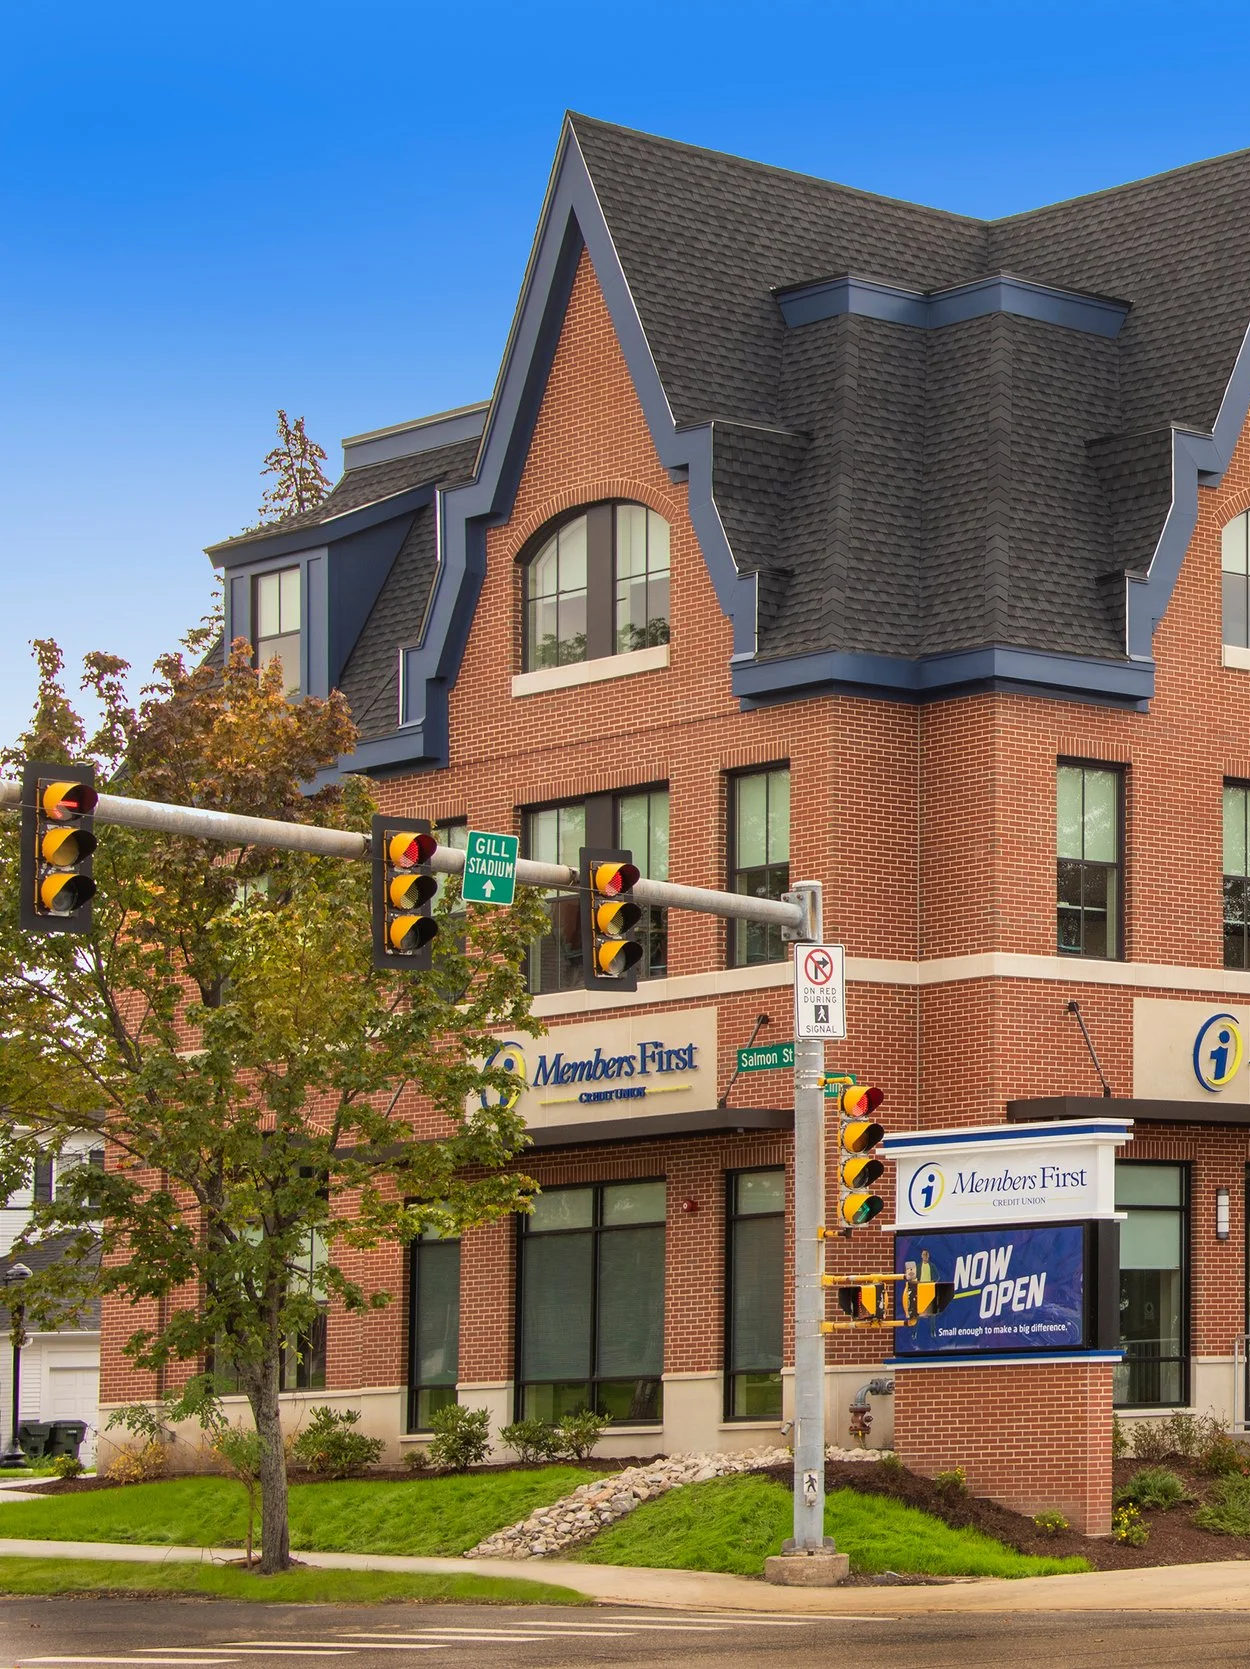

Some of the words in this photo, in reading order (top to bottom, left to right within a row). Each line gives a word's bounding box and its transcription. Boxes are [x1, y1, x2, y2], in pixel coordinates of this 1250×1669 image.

[476, 838, 509, 858] GILL
[468, 857, 514, 879] STADIUM
[803, 987, 816, 995] ON
[820, 987, 837, 995] RED
[803, 996, 837, 1004] DURING
[806, 1025, 837, 1034] SIGNAL
[531, 1047, 636, 1087] Members
[637, 1041, 698, 1074] First
[741, 1052, 778, 1067] Salmon
[782, 1048, 793, 1063] St
[578, 1089, 615, 1103] CREDIT
[614, 1087, 646, 1100] UNION
[951, 1169, 1037, 1194] Members
[1039, 1166, 1088, 1189] First
[992, 1198, 1020, 1207] CREDIT
[1021, 1197, 1046, 1205] UNION
[954, 1244, 1014, 1291] NOW
[979, 1272, 1047, 1319] OPEN
[938, 1327, 957, 1337] Small
[958, 1326, 983, 1337] enough
[984, 1326, 993, 1334] to
[993, 1325, 1012, 1334] make
[1019, 1324, 1030, 1334] big
[1031, 1323, 1068, 1333] difference.
